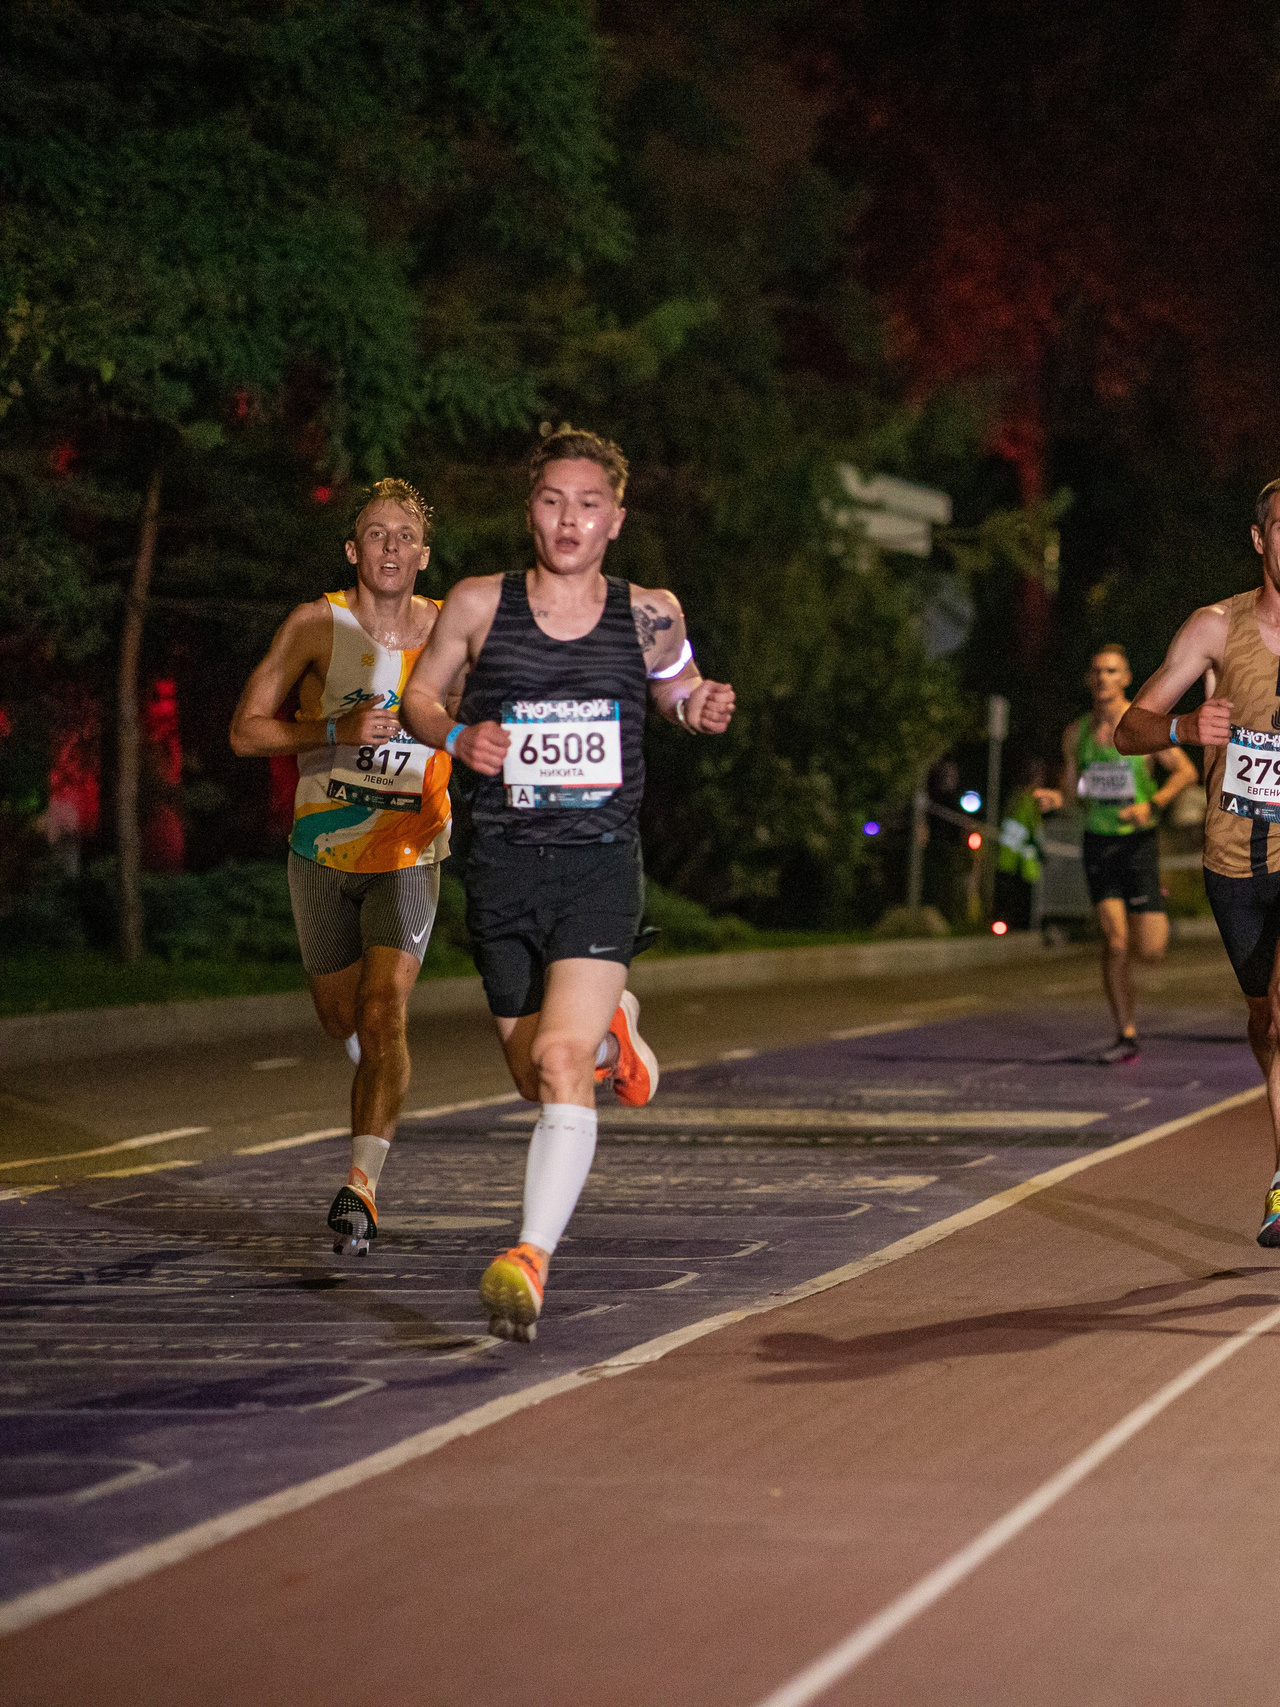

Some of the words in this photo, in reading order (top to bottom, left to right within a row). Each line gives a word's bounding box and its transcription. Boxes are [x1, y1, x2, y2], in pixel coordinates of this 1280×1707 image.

[513, 699, 612, 718] НОЧНОЙ
[520, 732, 605, 765] 6508
[356, 746, 412, 777] 817
[363, 775, 395, 786] ЛЕВОН
[540, 768, 584, 778] НИКИТА
